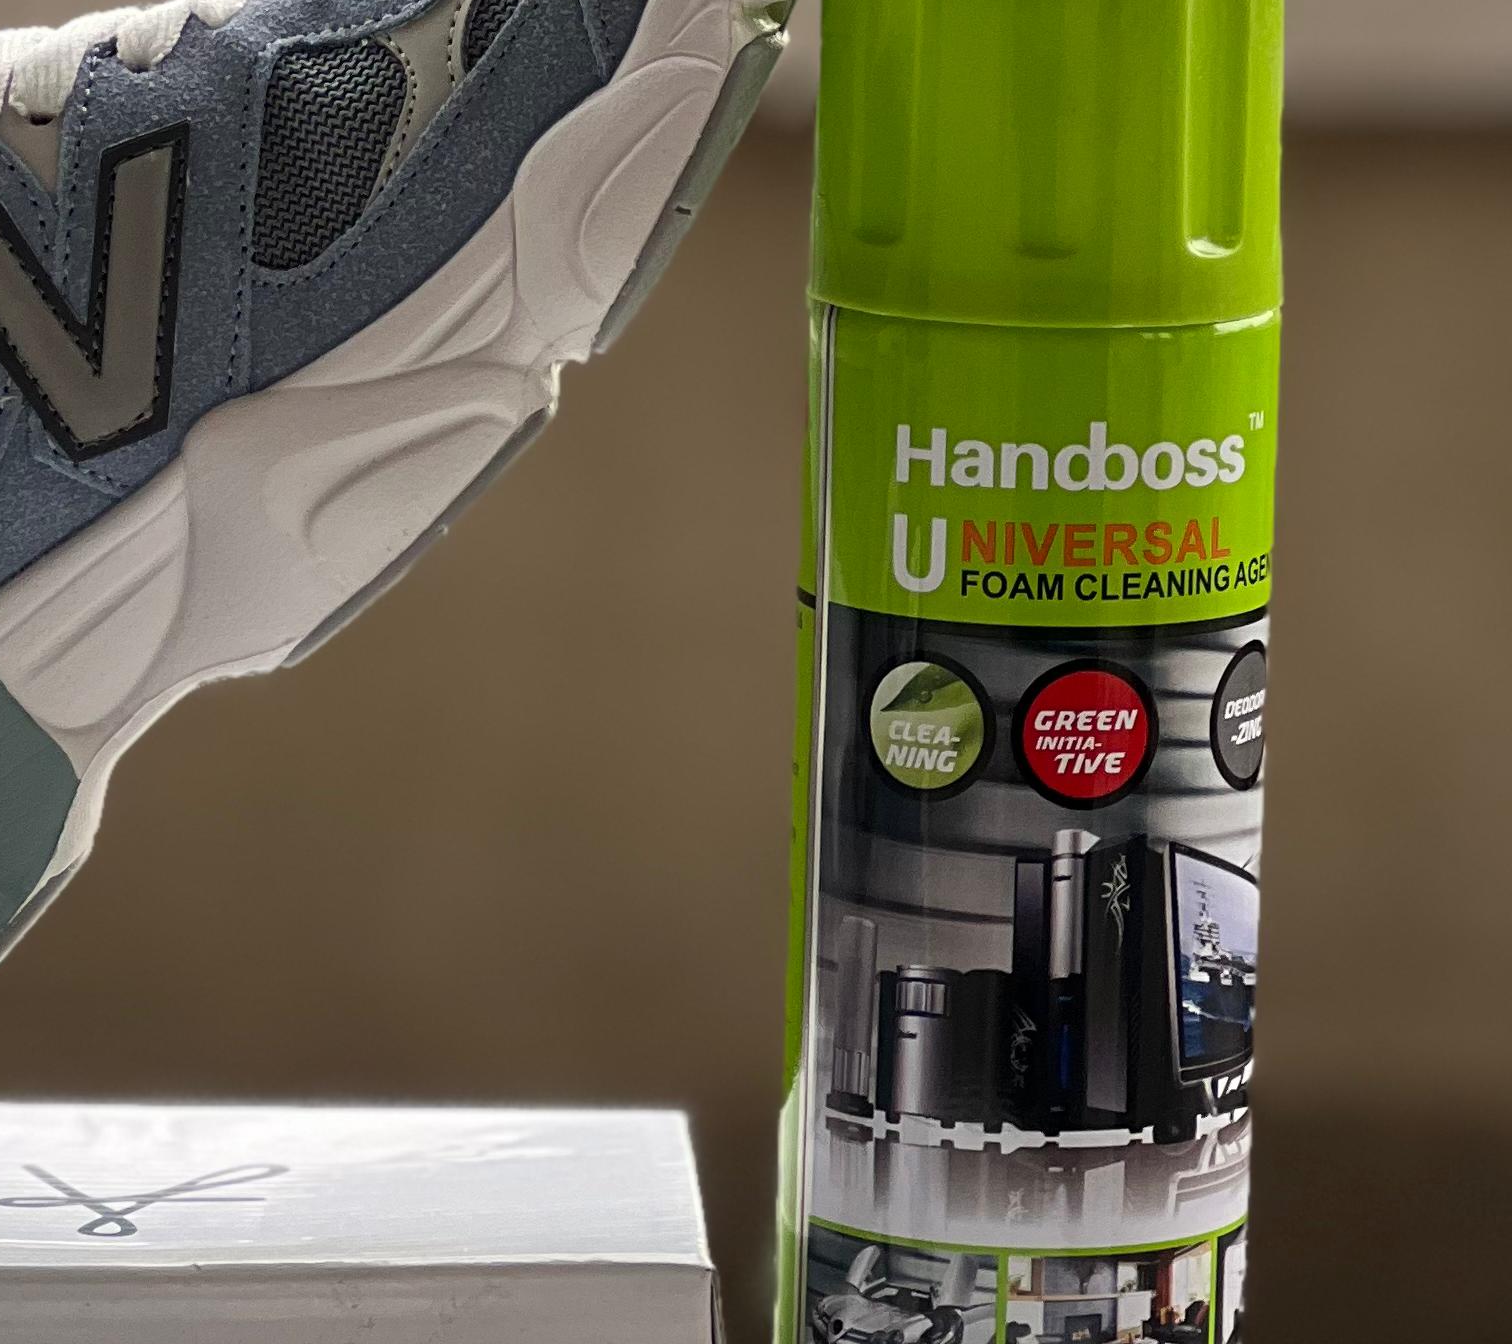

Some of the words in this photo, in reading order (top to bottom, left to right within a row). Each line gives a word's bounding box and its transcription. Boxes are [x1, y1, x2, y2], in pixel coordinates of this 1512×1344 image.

[895, 421, 1245, 491] Handboss
[960, 570, 1065, 601] FOAM
[1074, 564, 1230, 601] CLEANING
[889, 720, 961, 746] CLEA-
[1034, 709, 1138, 732] GREEN
[1035, 736, 1103, 751] INITIA-
[885, 744, 958, 774] NING
[1054, 752, 1126, 775] TIVE
